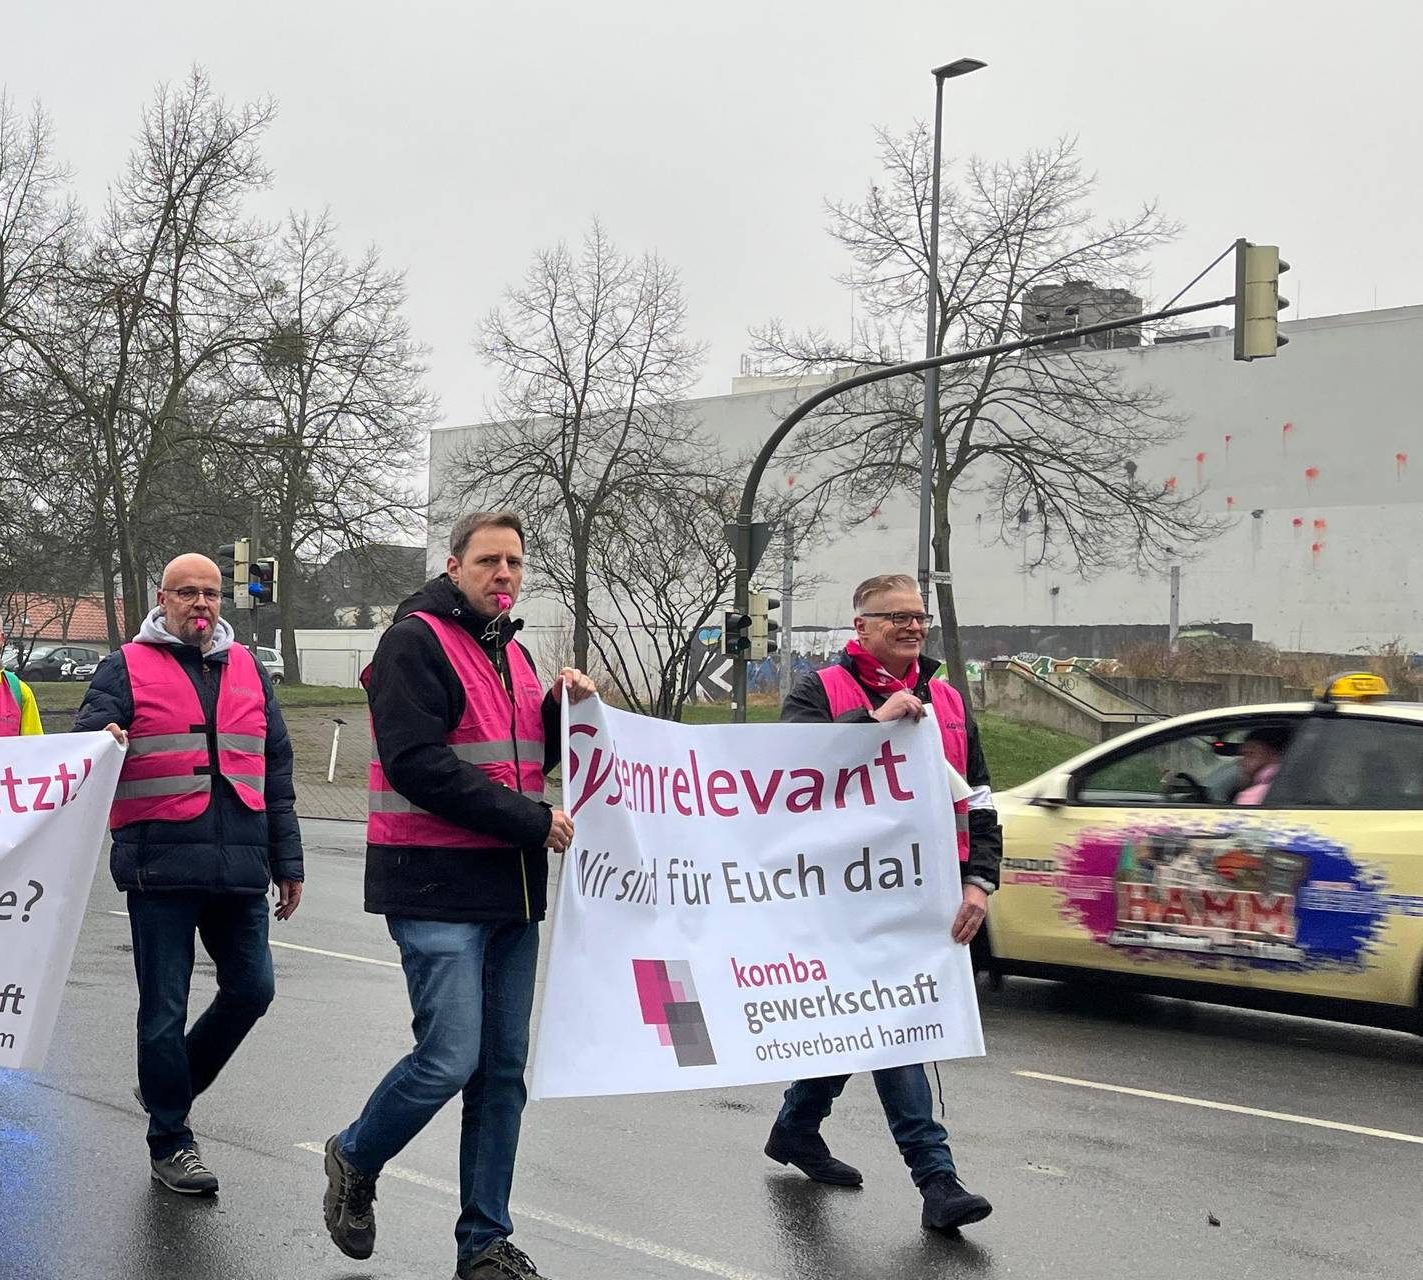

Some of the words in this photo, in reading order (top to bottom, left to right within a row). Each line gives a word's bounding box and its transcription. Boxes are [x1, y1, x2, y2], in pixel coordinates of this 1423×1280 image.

[569, 723, 915, 818] Sysemrelevant
[667, 858, 712, 905] für
[721, 854, 826, 904] Euch
[843, 843, 924, 892] da!
[730, 953, 827, 988] komba
[743, 973, 939, 1034] gewerkschaft
[755, 1027, 875, 1062] ortsverband
[878, 1022, 944, 1051] hamm
